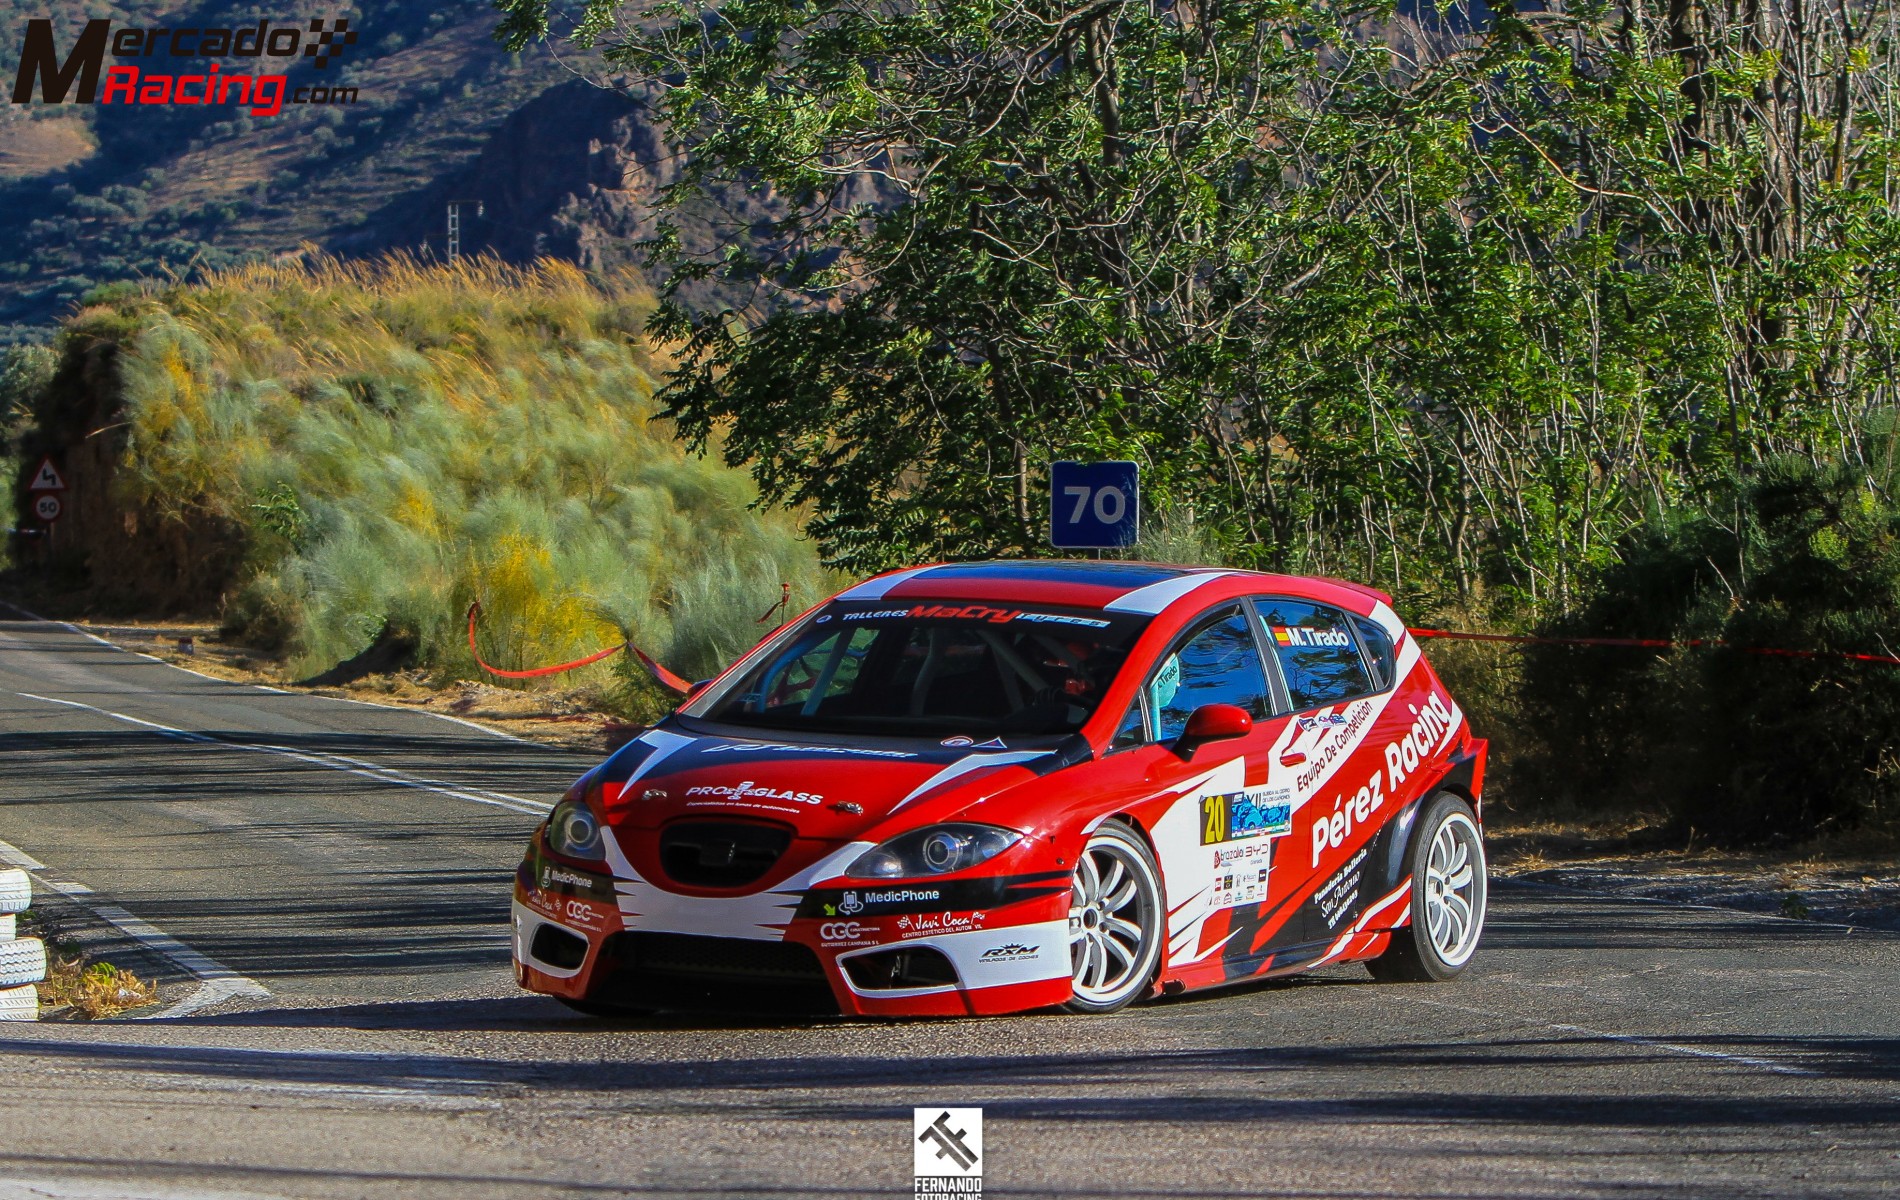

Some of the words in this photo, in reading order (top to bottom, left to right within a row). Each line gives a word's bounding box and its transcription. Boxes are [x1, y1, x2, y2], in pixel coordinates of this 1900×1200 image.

[40, 502, 57, 513] 50
[1064, 486, 1126, 525] 70
[843, 609, 909, 620] TALLERES
[906, 605, 1021, 624] MaCry
[1297, 757, 1326, 792] Equipo
[1325, 745, 1338, 763] De
[1204, 795, 1225, 844] 20
[1312, 770, 1384, 869] Pérez
[1245, 843, 1269, 858] BYD
[551, 870, 593, 888] MedicPhone
[865, 890, 940, 904] MedicPhone
[566, 900, 592, 922] CGC
[915, 914, 940, 930] Javi
[942, 911, 970, 927] Coca
[820, 921, 860, 940] CGC
[901, 930, 922, 939] CENTRO
